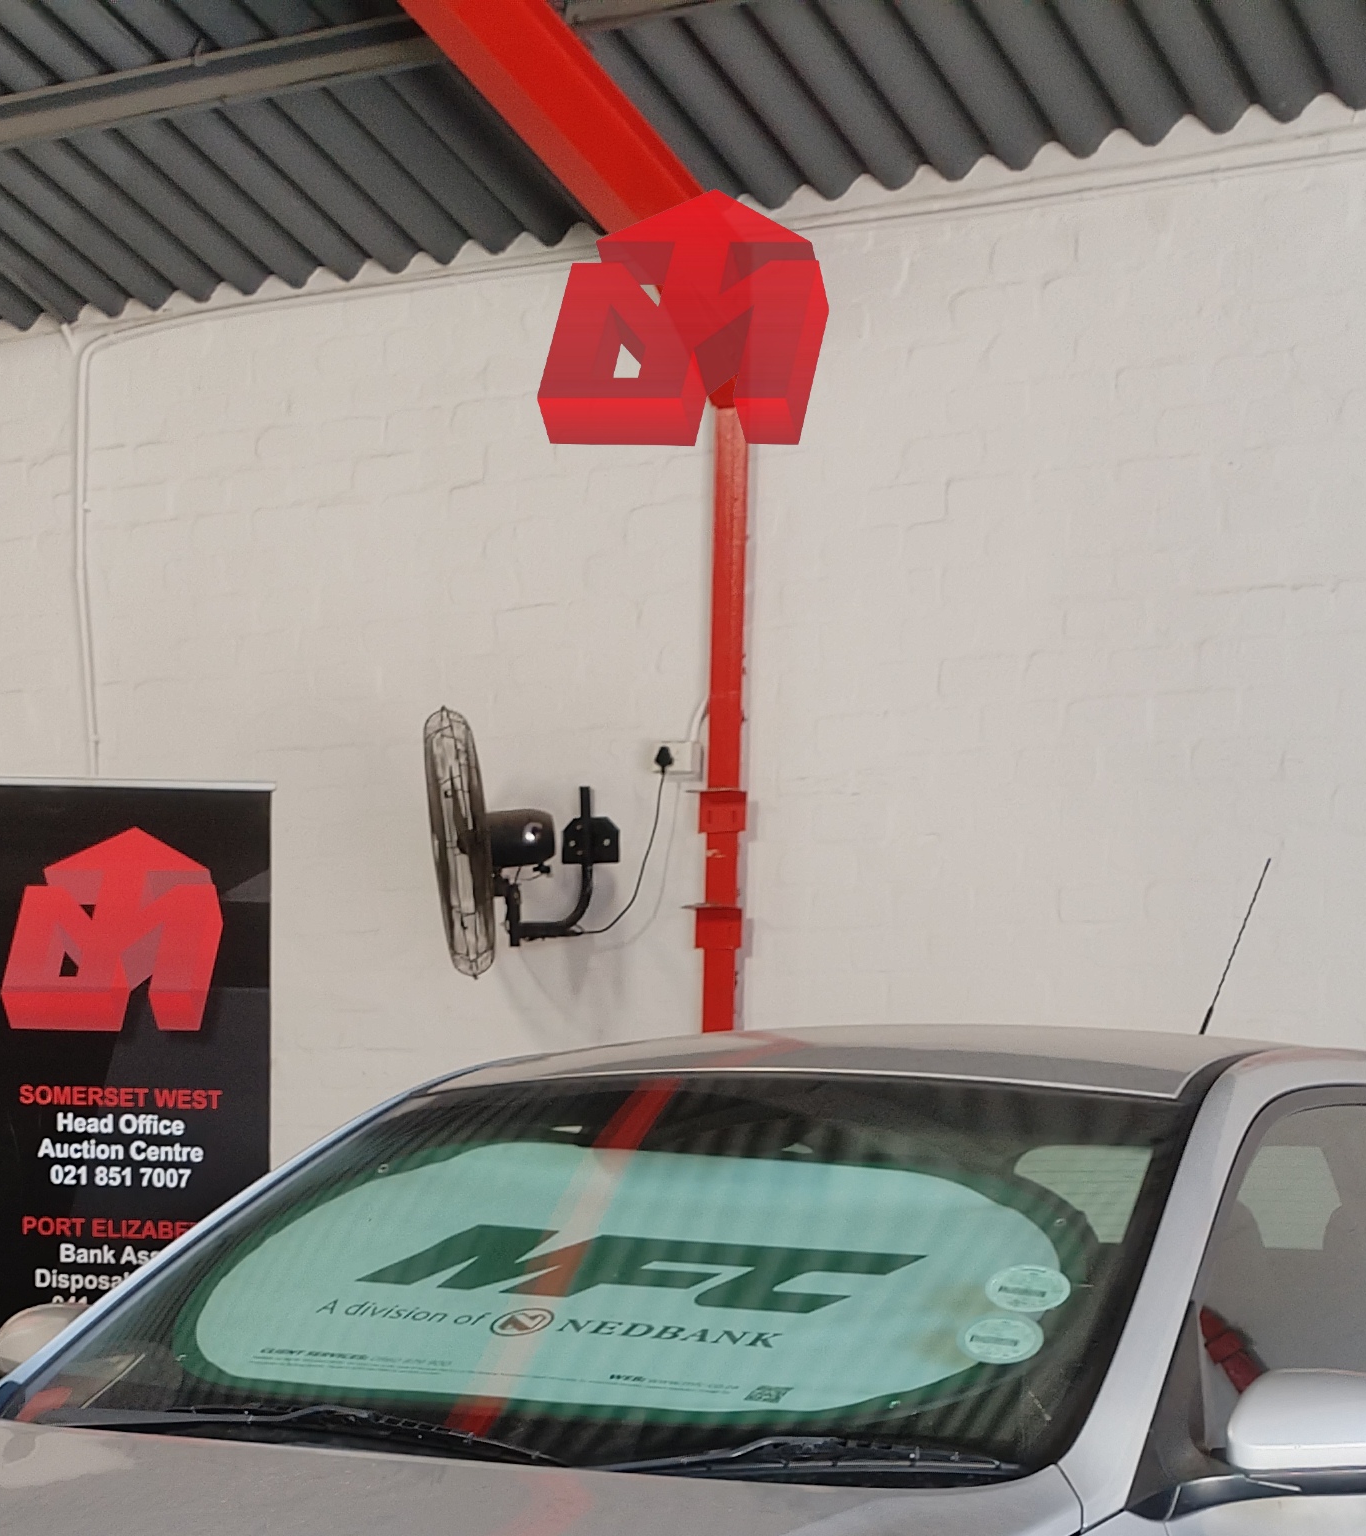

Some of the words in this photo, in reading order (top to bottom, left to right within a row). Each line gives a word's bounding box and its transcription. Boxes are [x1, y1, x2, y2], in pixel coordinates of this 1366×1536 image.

[19, 1084, 149, 1109] SOMERSET
[154, 1086, 223, 1111] WEST
[56, 1112, 114, 1135] Head
[118, 1112, 186, 1136] Office
[37, 1138, 124, 1161] Auction
[129, 1141, 204, 1164] Centre
[49, 1165, 89, 1187] 021
[94, 1166, 132, 1188] 851
[138, 1167, 192, 1190] 7007
[21, 1216, 86, 1238] PORT
[59, 1242, 116, 1264] Bank
[354, 1223, 930, 1314] MFC
[316, 1299, 340, 1315] A
[344, 1299, 447, 1327] division
[454, 1309, 494, 1327] of
[555, 1318, 784, 1349] NEDBANK
